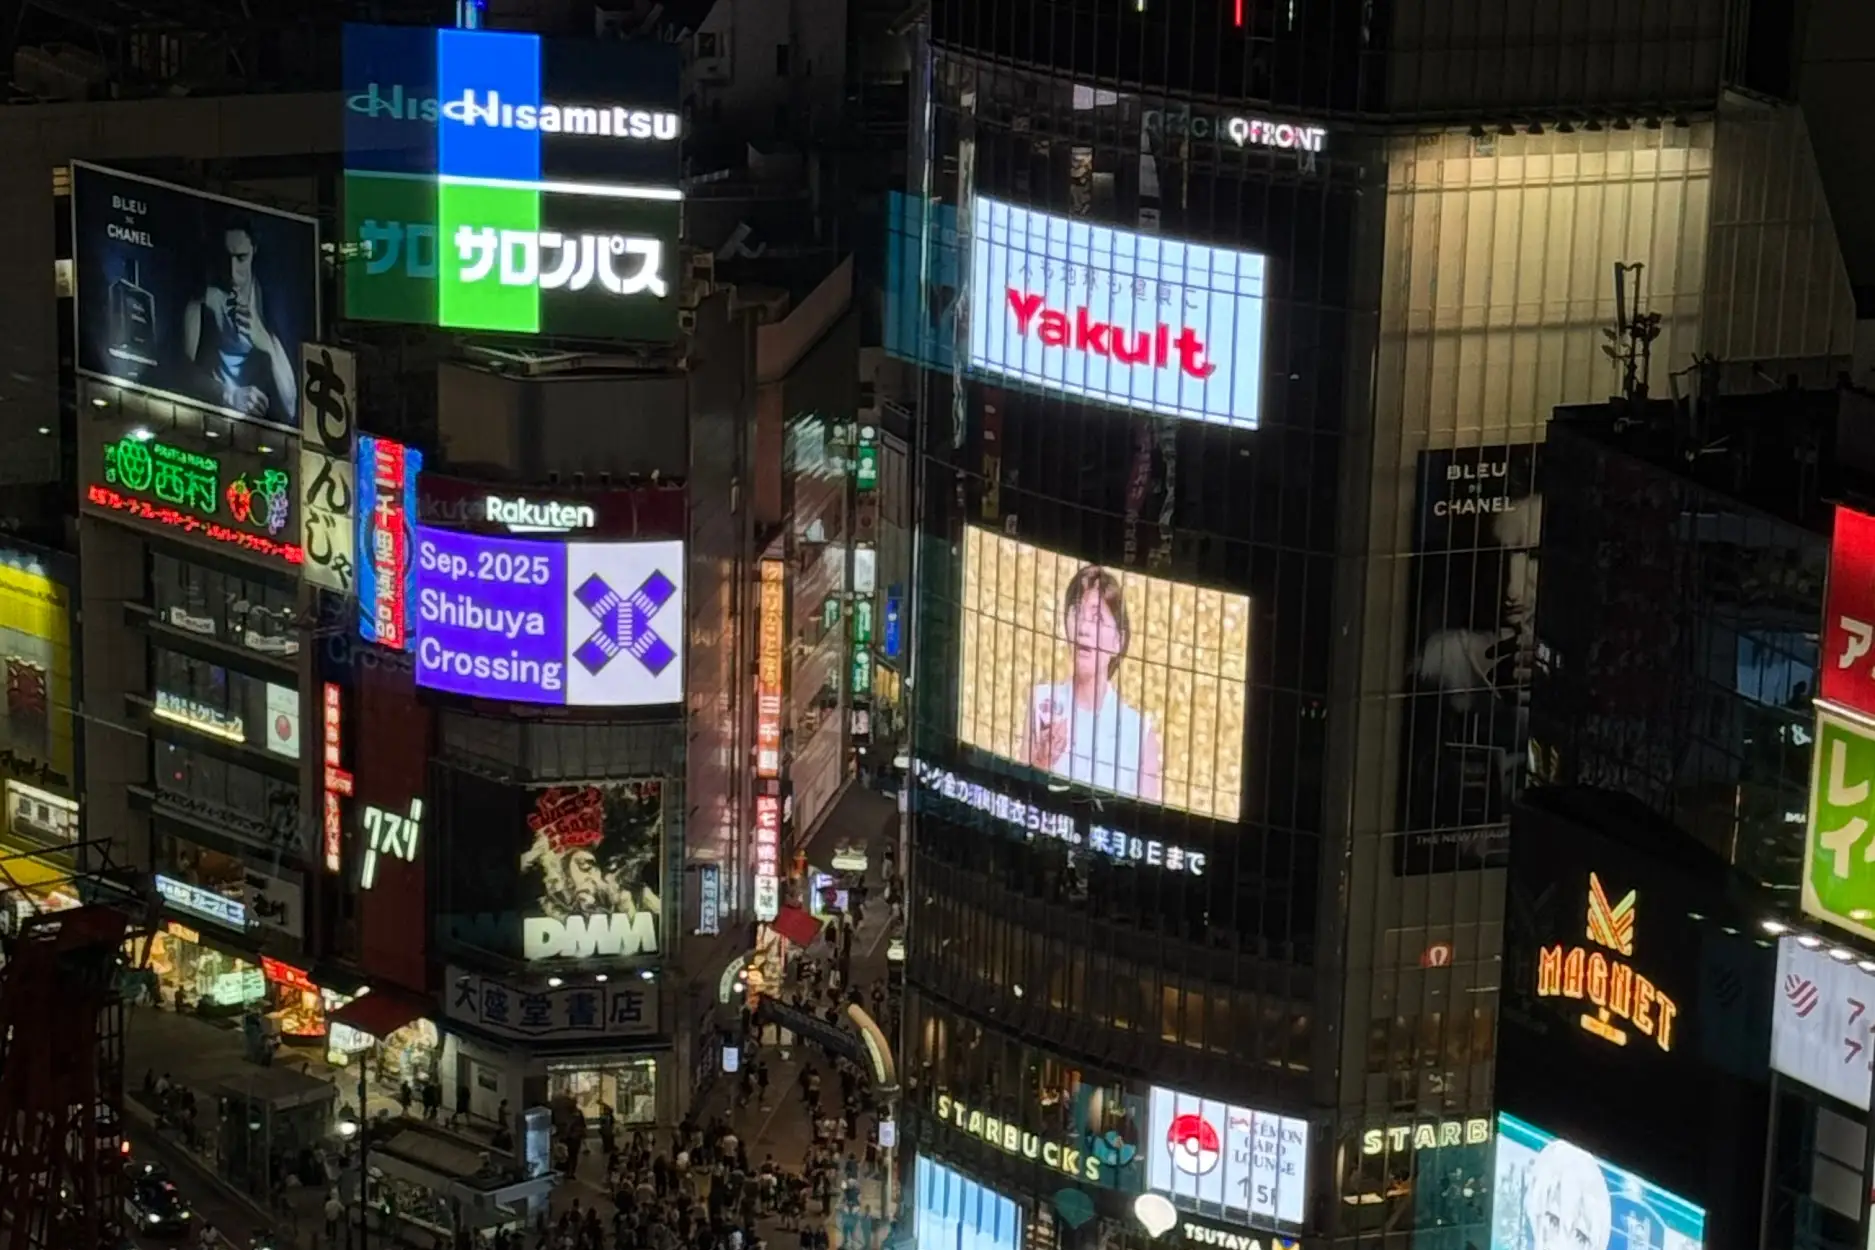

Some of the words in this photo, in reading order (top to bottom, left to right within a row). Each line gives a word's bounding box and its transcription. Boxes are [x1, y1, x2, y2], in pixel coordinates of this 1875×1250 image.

[443, 88, 681, 141] Hisamitsu
[112, 195, 147, 215] BLEU
[107, 224, 154, 248] CHANEL
[454, 224, 668, 299] サロンパス
[1005, 286, 1216, 381] Yakult
[155, 459, 216, 514] 西村
[306, 349, 353, 590] もんじゃ
[1446, 461, 1507, 480] BLEU
[486, 496, 595, 528] Rakuten
[1433, 496, 1516, 516] CHANEL
[420, 541, 550, 585] Sep.2025
[420, 588, 545, 639] Shibuya
[420, 637, 563, 691] Crossing
[1838, 615, 1875, 678] ア
[361, 798, 422, 890] クスリ
[524, 911, 657, 959] DMM
[1537, 944, 1676, 1052] MAGNET
[938, 1095, 1101, 1180] STARBUCKS
[1363, 1119, 1488, 1155] STARB
